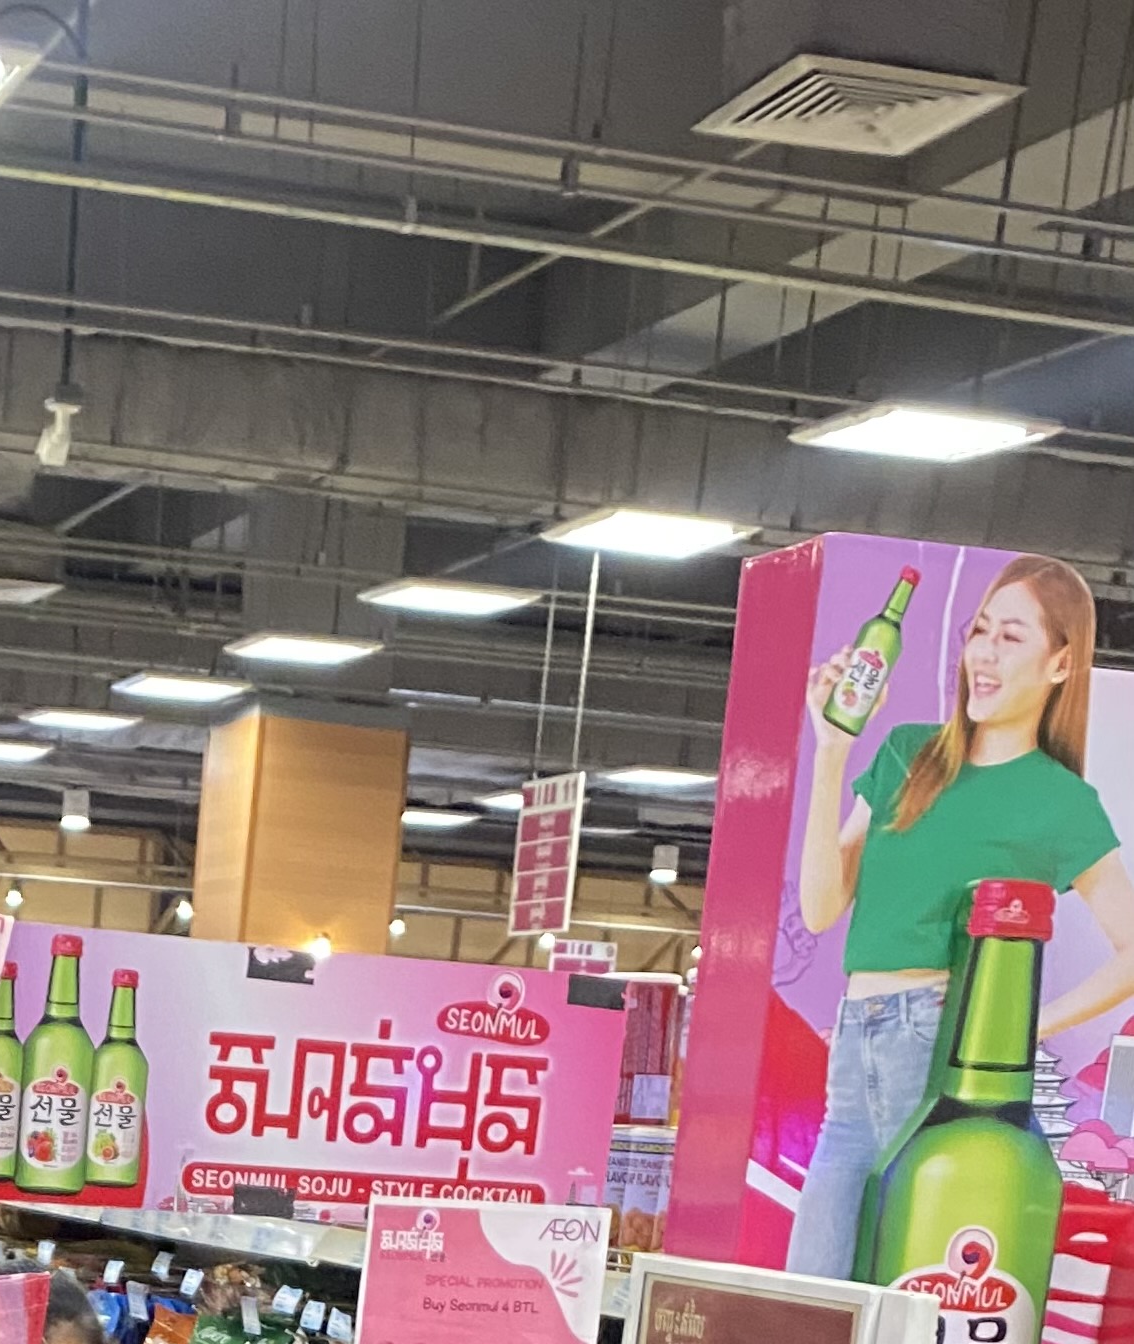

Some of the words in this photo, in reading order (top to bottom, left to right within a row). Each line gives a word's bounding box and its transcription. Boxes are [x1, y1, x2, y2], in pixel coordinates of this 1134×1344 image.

[445, 1007, 541, 1040] SEONMUL
[29, 1095, 83, 1127] 선물
[93, 1103, 138, 1130] 선물
[298, 1174, 352, 1197] SOJU
[371, 1179, 434, 1199] STYLE
[425, 1274, 473, 1288] SPECIAL
[477, 1276, 544, 1290] PROMOTION
[423, 1297, 446, 1313] Buy
[450, 1298, 499, 1313] Seonmul
[502, 1301, 509, 1312] 4
[513, 1300, 539, 1314] BTL
